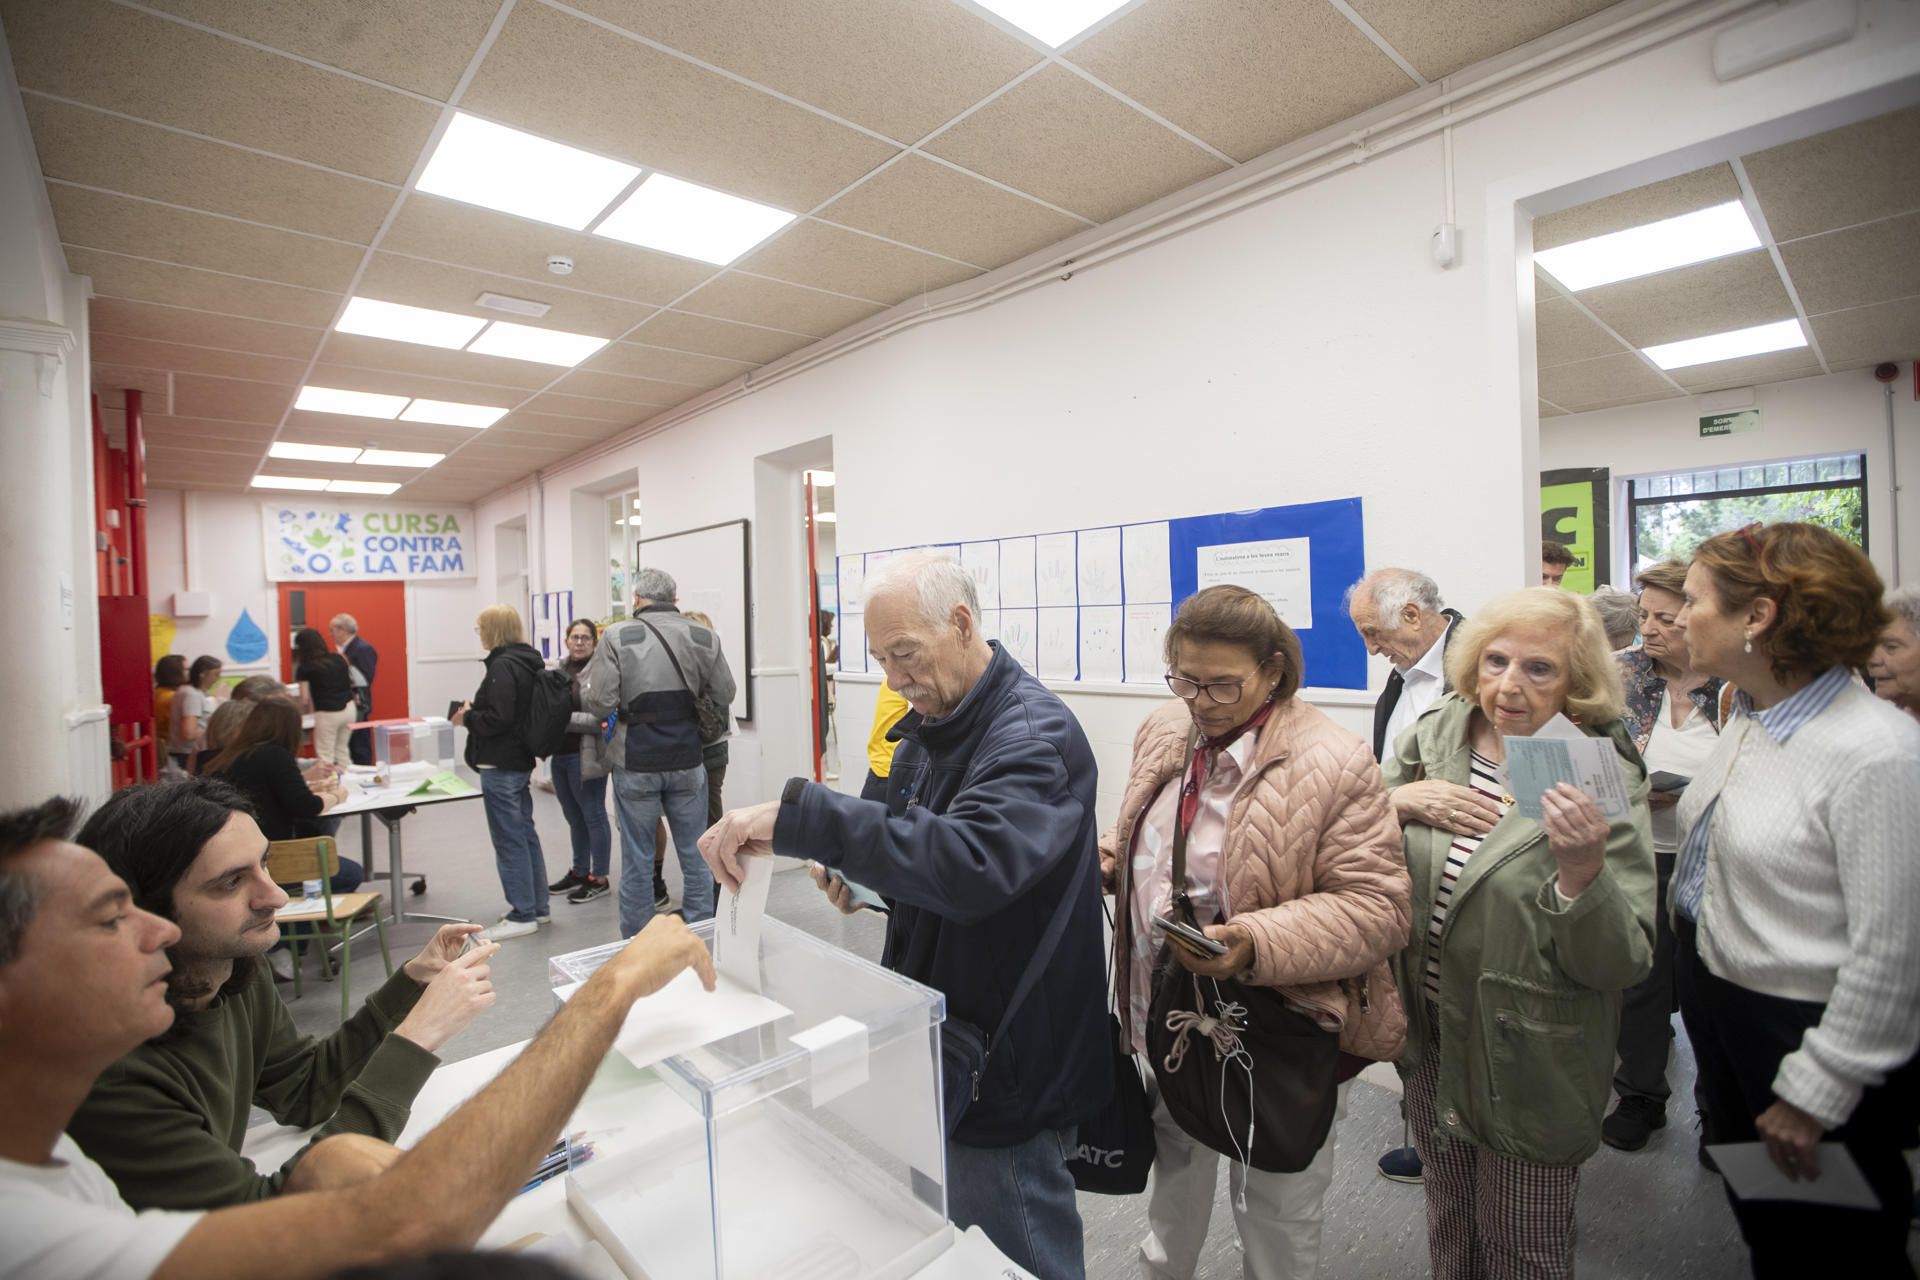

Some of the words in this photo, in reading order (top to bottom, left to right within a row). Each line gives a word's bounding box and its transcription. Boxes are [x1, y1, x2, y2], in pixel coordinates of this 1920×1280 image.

[363, 513, 461, 533] CURSA
[364, 536, 462, 552] CONTRA
[364, 555, 397, 573] LA
[408, 553, 464, 572] FAM
